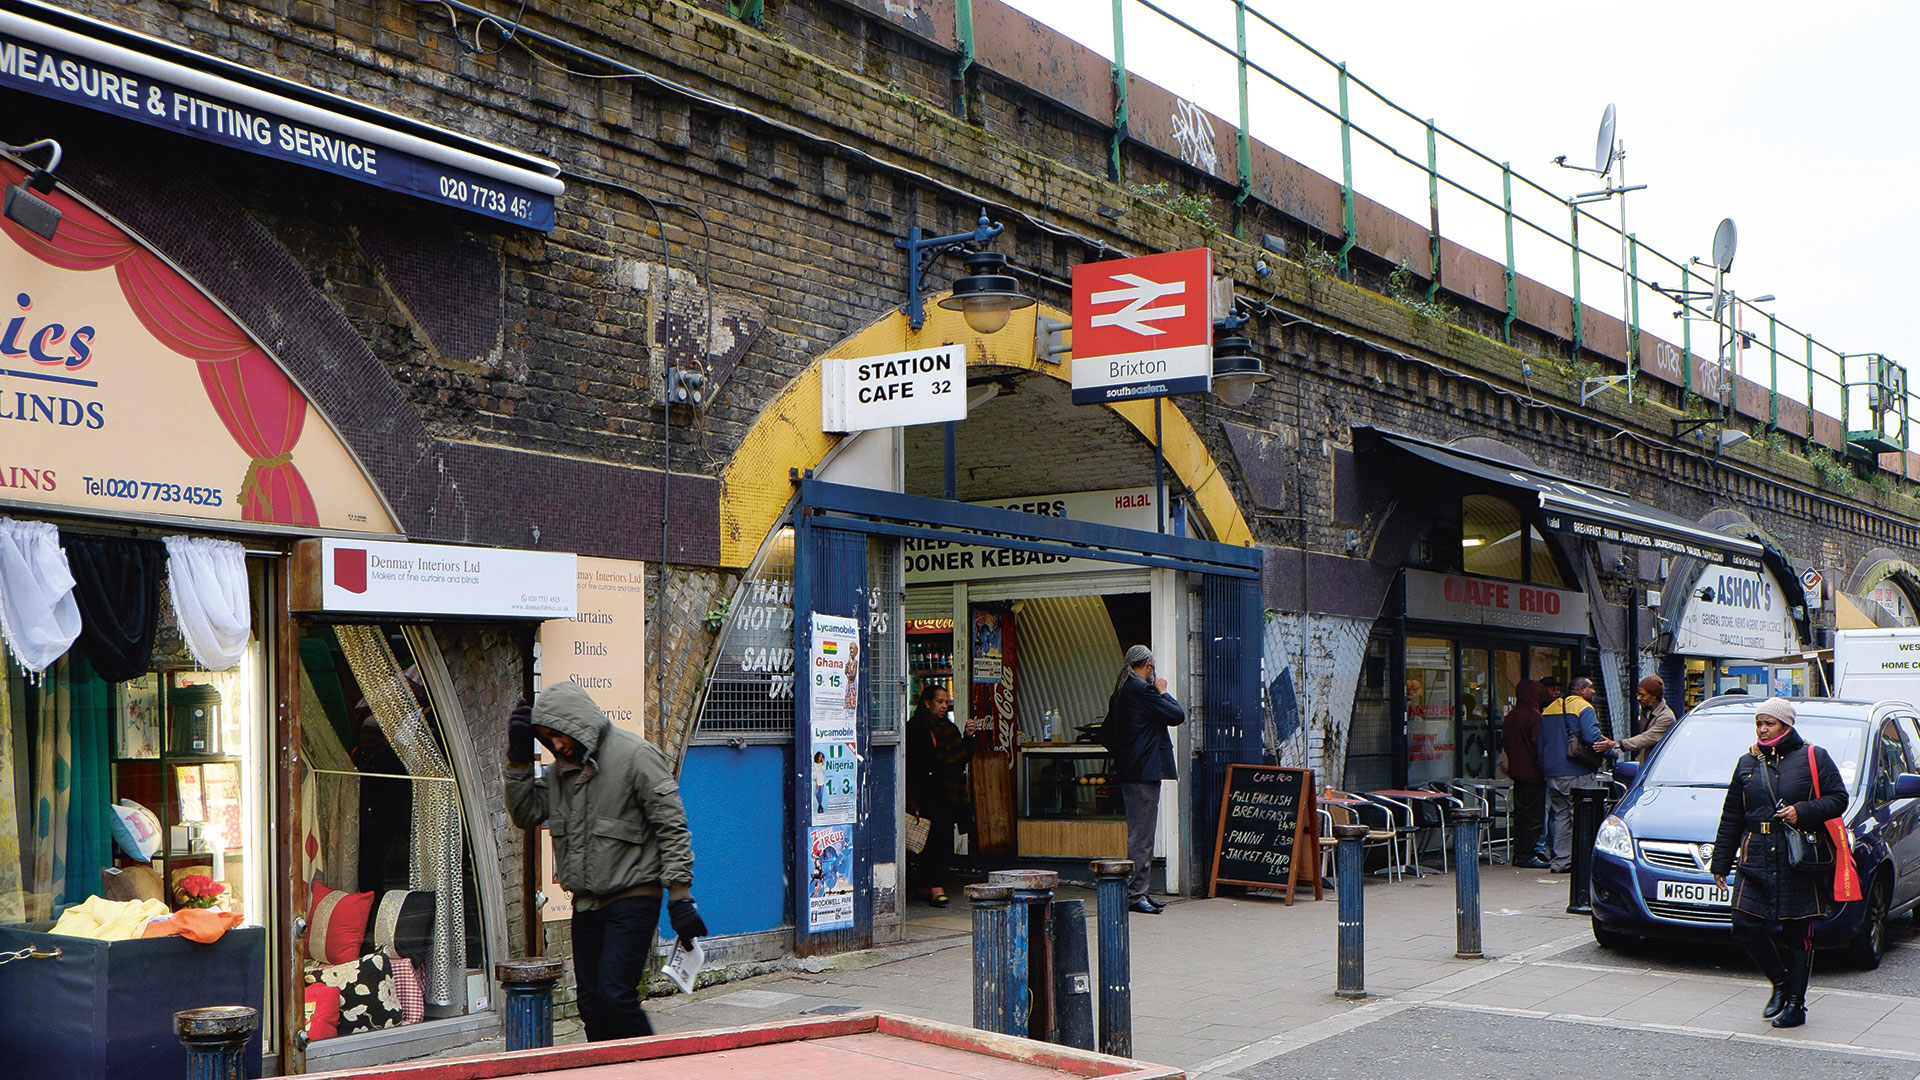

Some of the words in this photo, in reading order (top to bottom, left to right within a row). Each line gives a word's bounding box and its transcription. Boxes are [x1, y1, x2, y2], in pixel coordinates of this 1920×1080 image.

[0, 42, 139, 109] MEASURE
[147, 85, 166, 117] &
[174, 92, 272, 145] FITTING
[278, 123, 377, 175] SERVICE
[440, 175, 468, 202] 020
[471, 184, 506, 213] 7733
[510, 196, 532, 221] 45
[858, 353, 951, 381] STATION
[1109, 359, 1167, 378] Brixton
[858, 381, 914, 404] CAFE
[931, 379, 952, 395] 32
[140, 481, 181, 503] 7733
[183, 486, 223, 507] 4525
[370, 555, 415, 573] Denmay
[417, 557, 461, 573] Interiors
[463, 560, 481, 573] Ltd
[371, 570, 396, 581] Makers
[398, 572, 406, 581] of
[406, 573, 420, 583] fine
[421, 574, 446, 583] curtains
[447, 575, 460, 584] and
[461, 575, 480, 585] blinds
[596, 571, 627, 583] Interiors
[629, 573, 641, 584] Ltd
[598, 584, 617, 592] curtains
[618, 584, 627, 592] and
[1444, 577, 1509, 608] CAFE
[1519, 587, 1560, 615] RIO
[1717, 575, 1771, 612] ASHOK'S
[568, 609, 613, 624] urtains
[737, 605, 777, 631] HOT
[816, 622, 856, 636] Lycamobile
[574, 640, 608, 656] Blinds
[741, 646, 794, 672] SAND
[816, 656, 843, 668] Ghana
[569, 673, 612, 688] Shutters
[597, 705, 632, 721] ervice
[815, 728, 854, 738] Lycamobile
[826, 761, 854, 772] Nigeria
[1231, 805, 1293, 821] BREAKFAST
[812, 831, 844, 855] CIRCUS
[1226, 847, 1262, 862] JACKET
[1664, 883, 1704, 900] WR60
